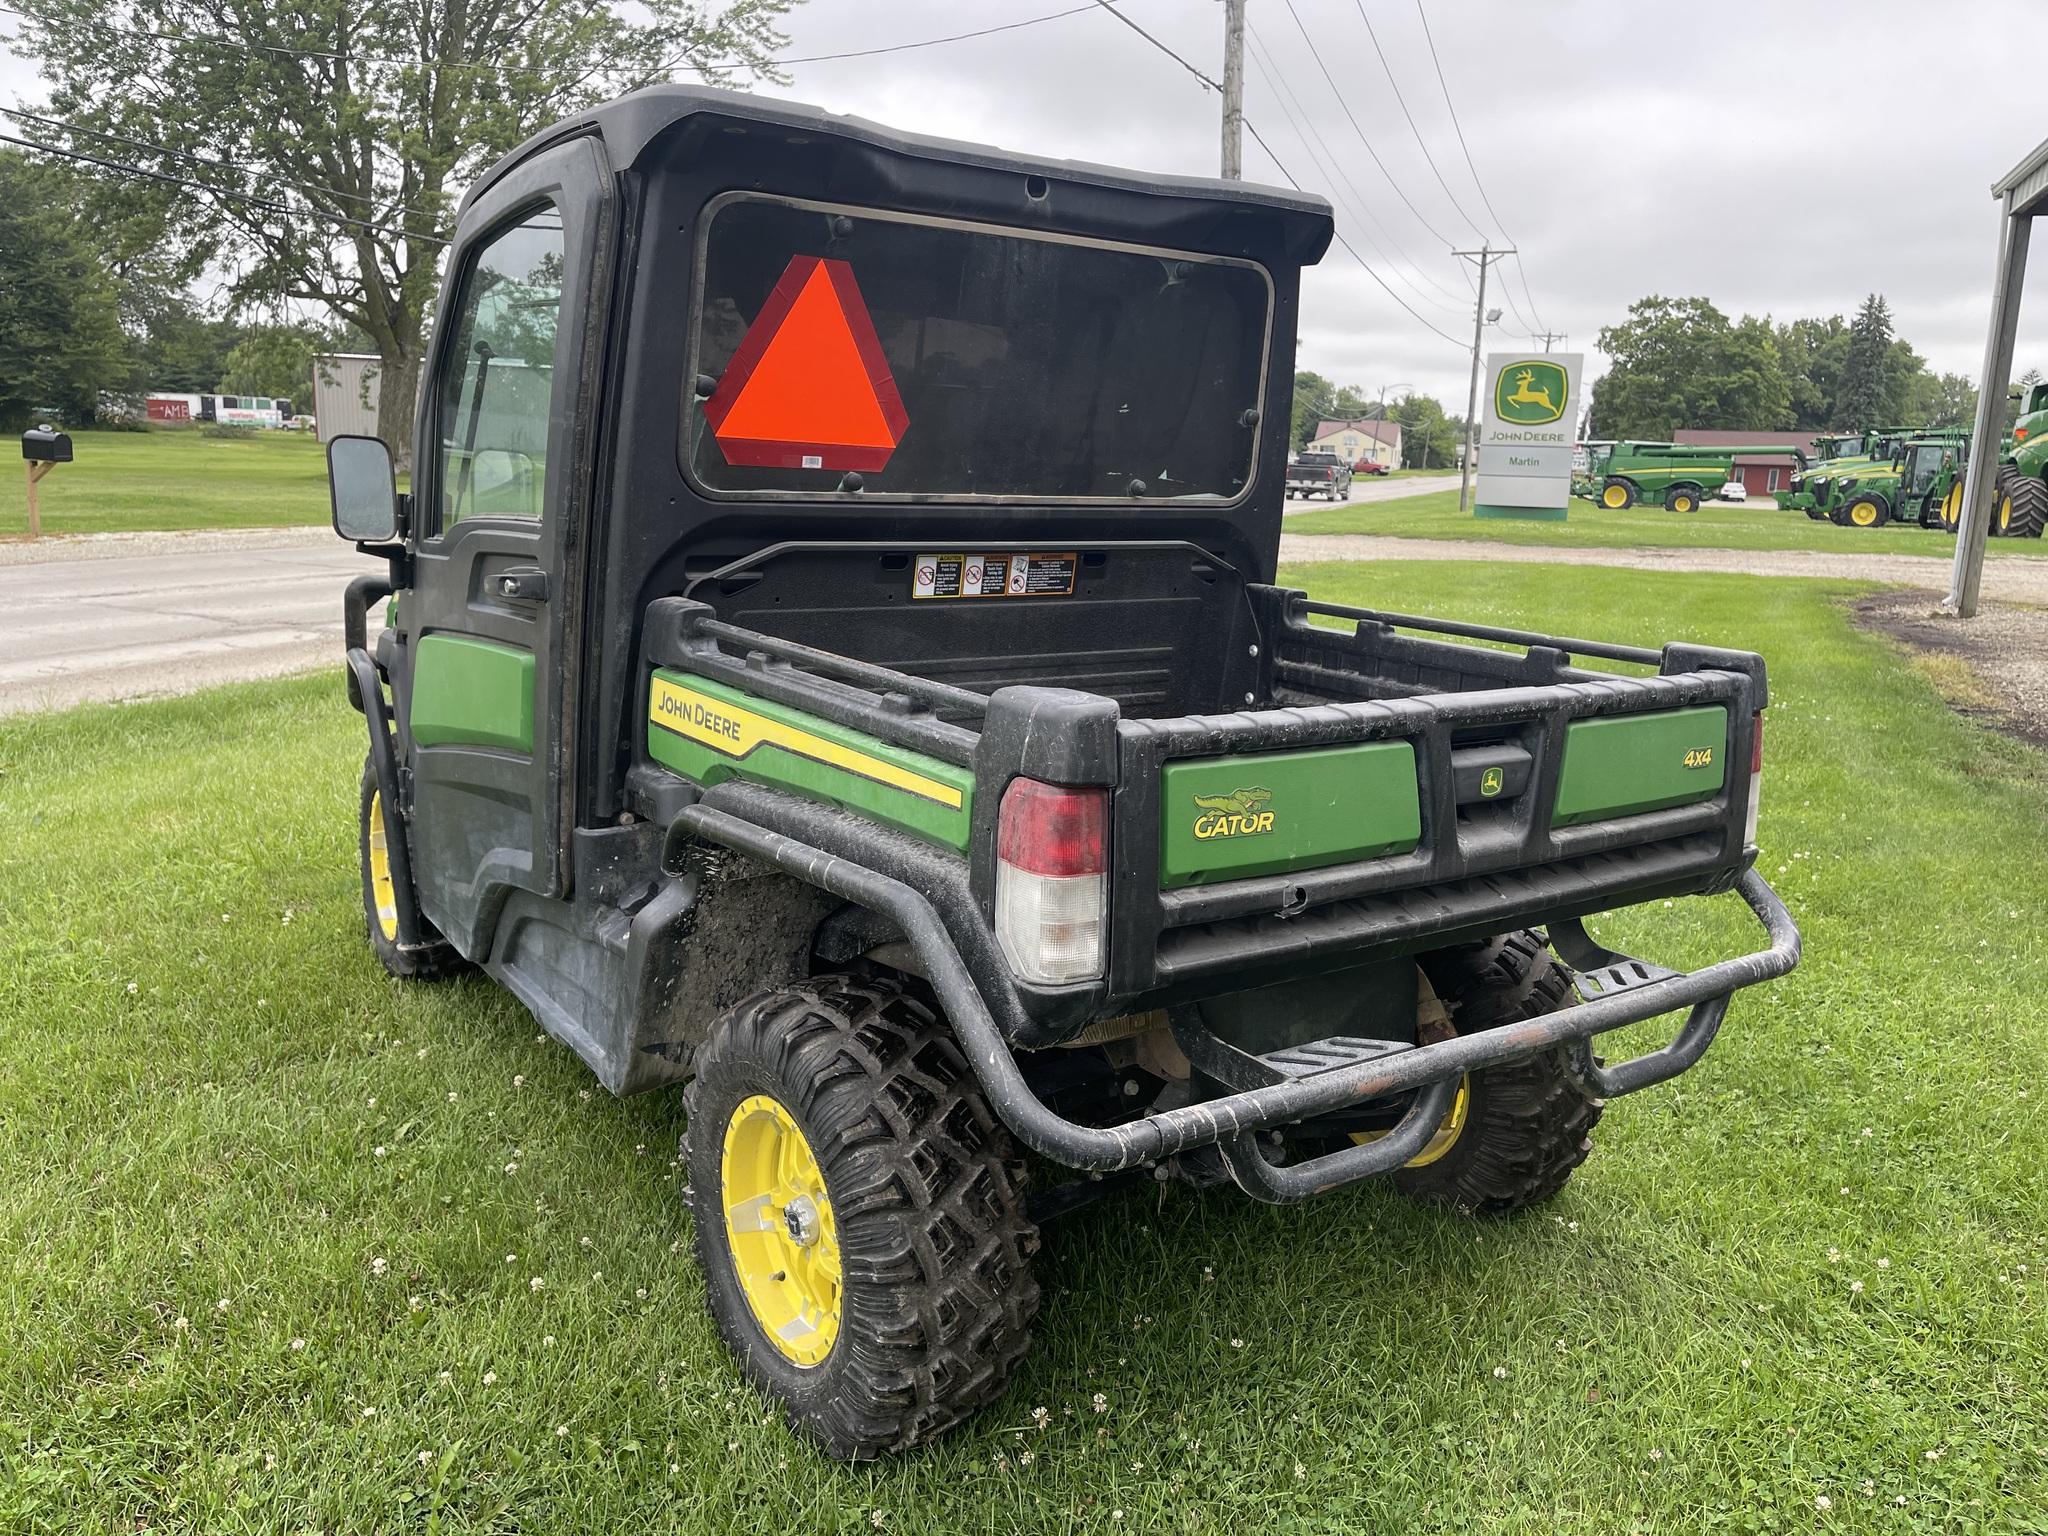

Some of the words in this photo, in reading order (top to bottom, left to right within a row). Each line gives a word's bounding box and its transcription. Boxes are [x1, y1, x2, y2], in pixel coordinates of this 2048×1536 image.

[1489, 431, 1522, 441] JOHN
[1523, 431, 1565, 442] DEERE
[1509, 457, 1540, 466] Martin
[658, 690, 692, 722] JOHN
[694, 703, 741, 742] DEERE
[1194, 811, 1276, 839] GATOR
